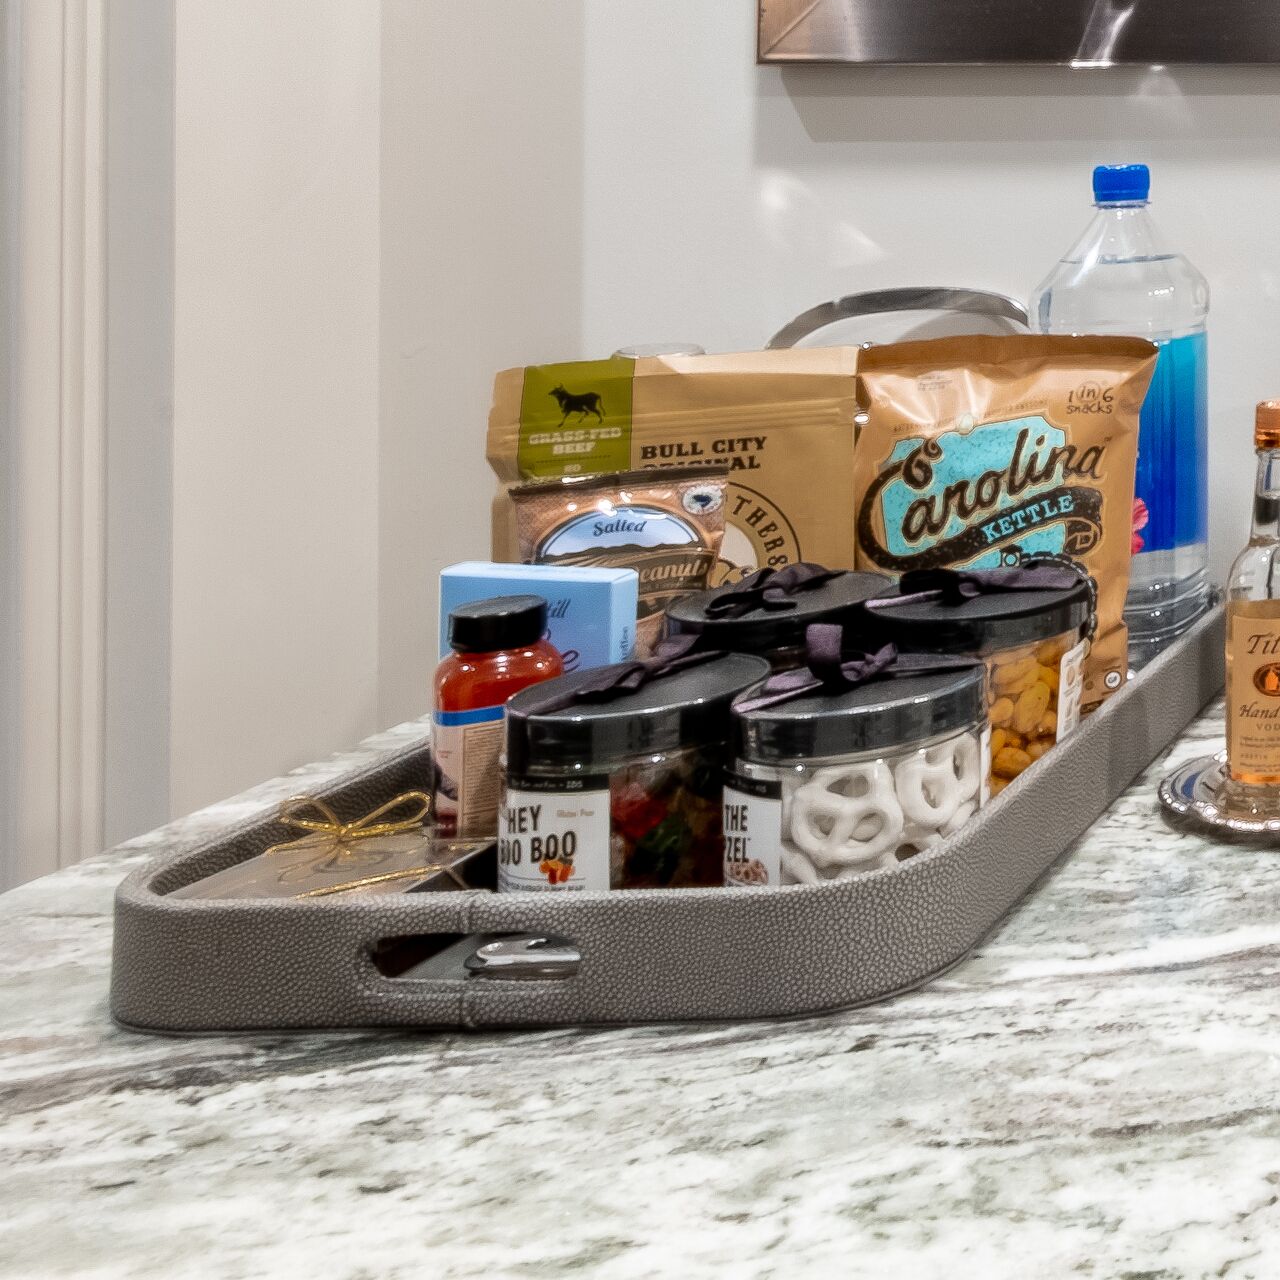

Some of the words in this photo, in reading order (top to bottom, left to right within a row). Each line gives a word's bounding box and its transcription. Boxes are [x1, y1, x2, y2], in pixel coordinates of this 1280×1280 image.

[1080, 385, 1100, 401] in
[1101, 386, 1115, 403] 6
[1065, 403, 1114, 416] snacks
[552, 441, 596, 455] BEEF
[640, 441, 706, 461] BULL
[711, 435, 768, 456] CITY
[858, 428, 1107, 562] Carolina
[592, 520, 649, 538] Salted
[981, 493, 1077, 544] KETTLE
[639, 559, 709, 584] eanuts
[506, 804, 542, 834] HEY
[724, 803, 749, 832] THE
[530, 830, 578, 864] BOO
[726, 835, 750, 863] ZEL
